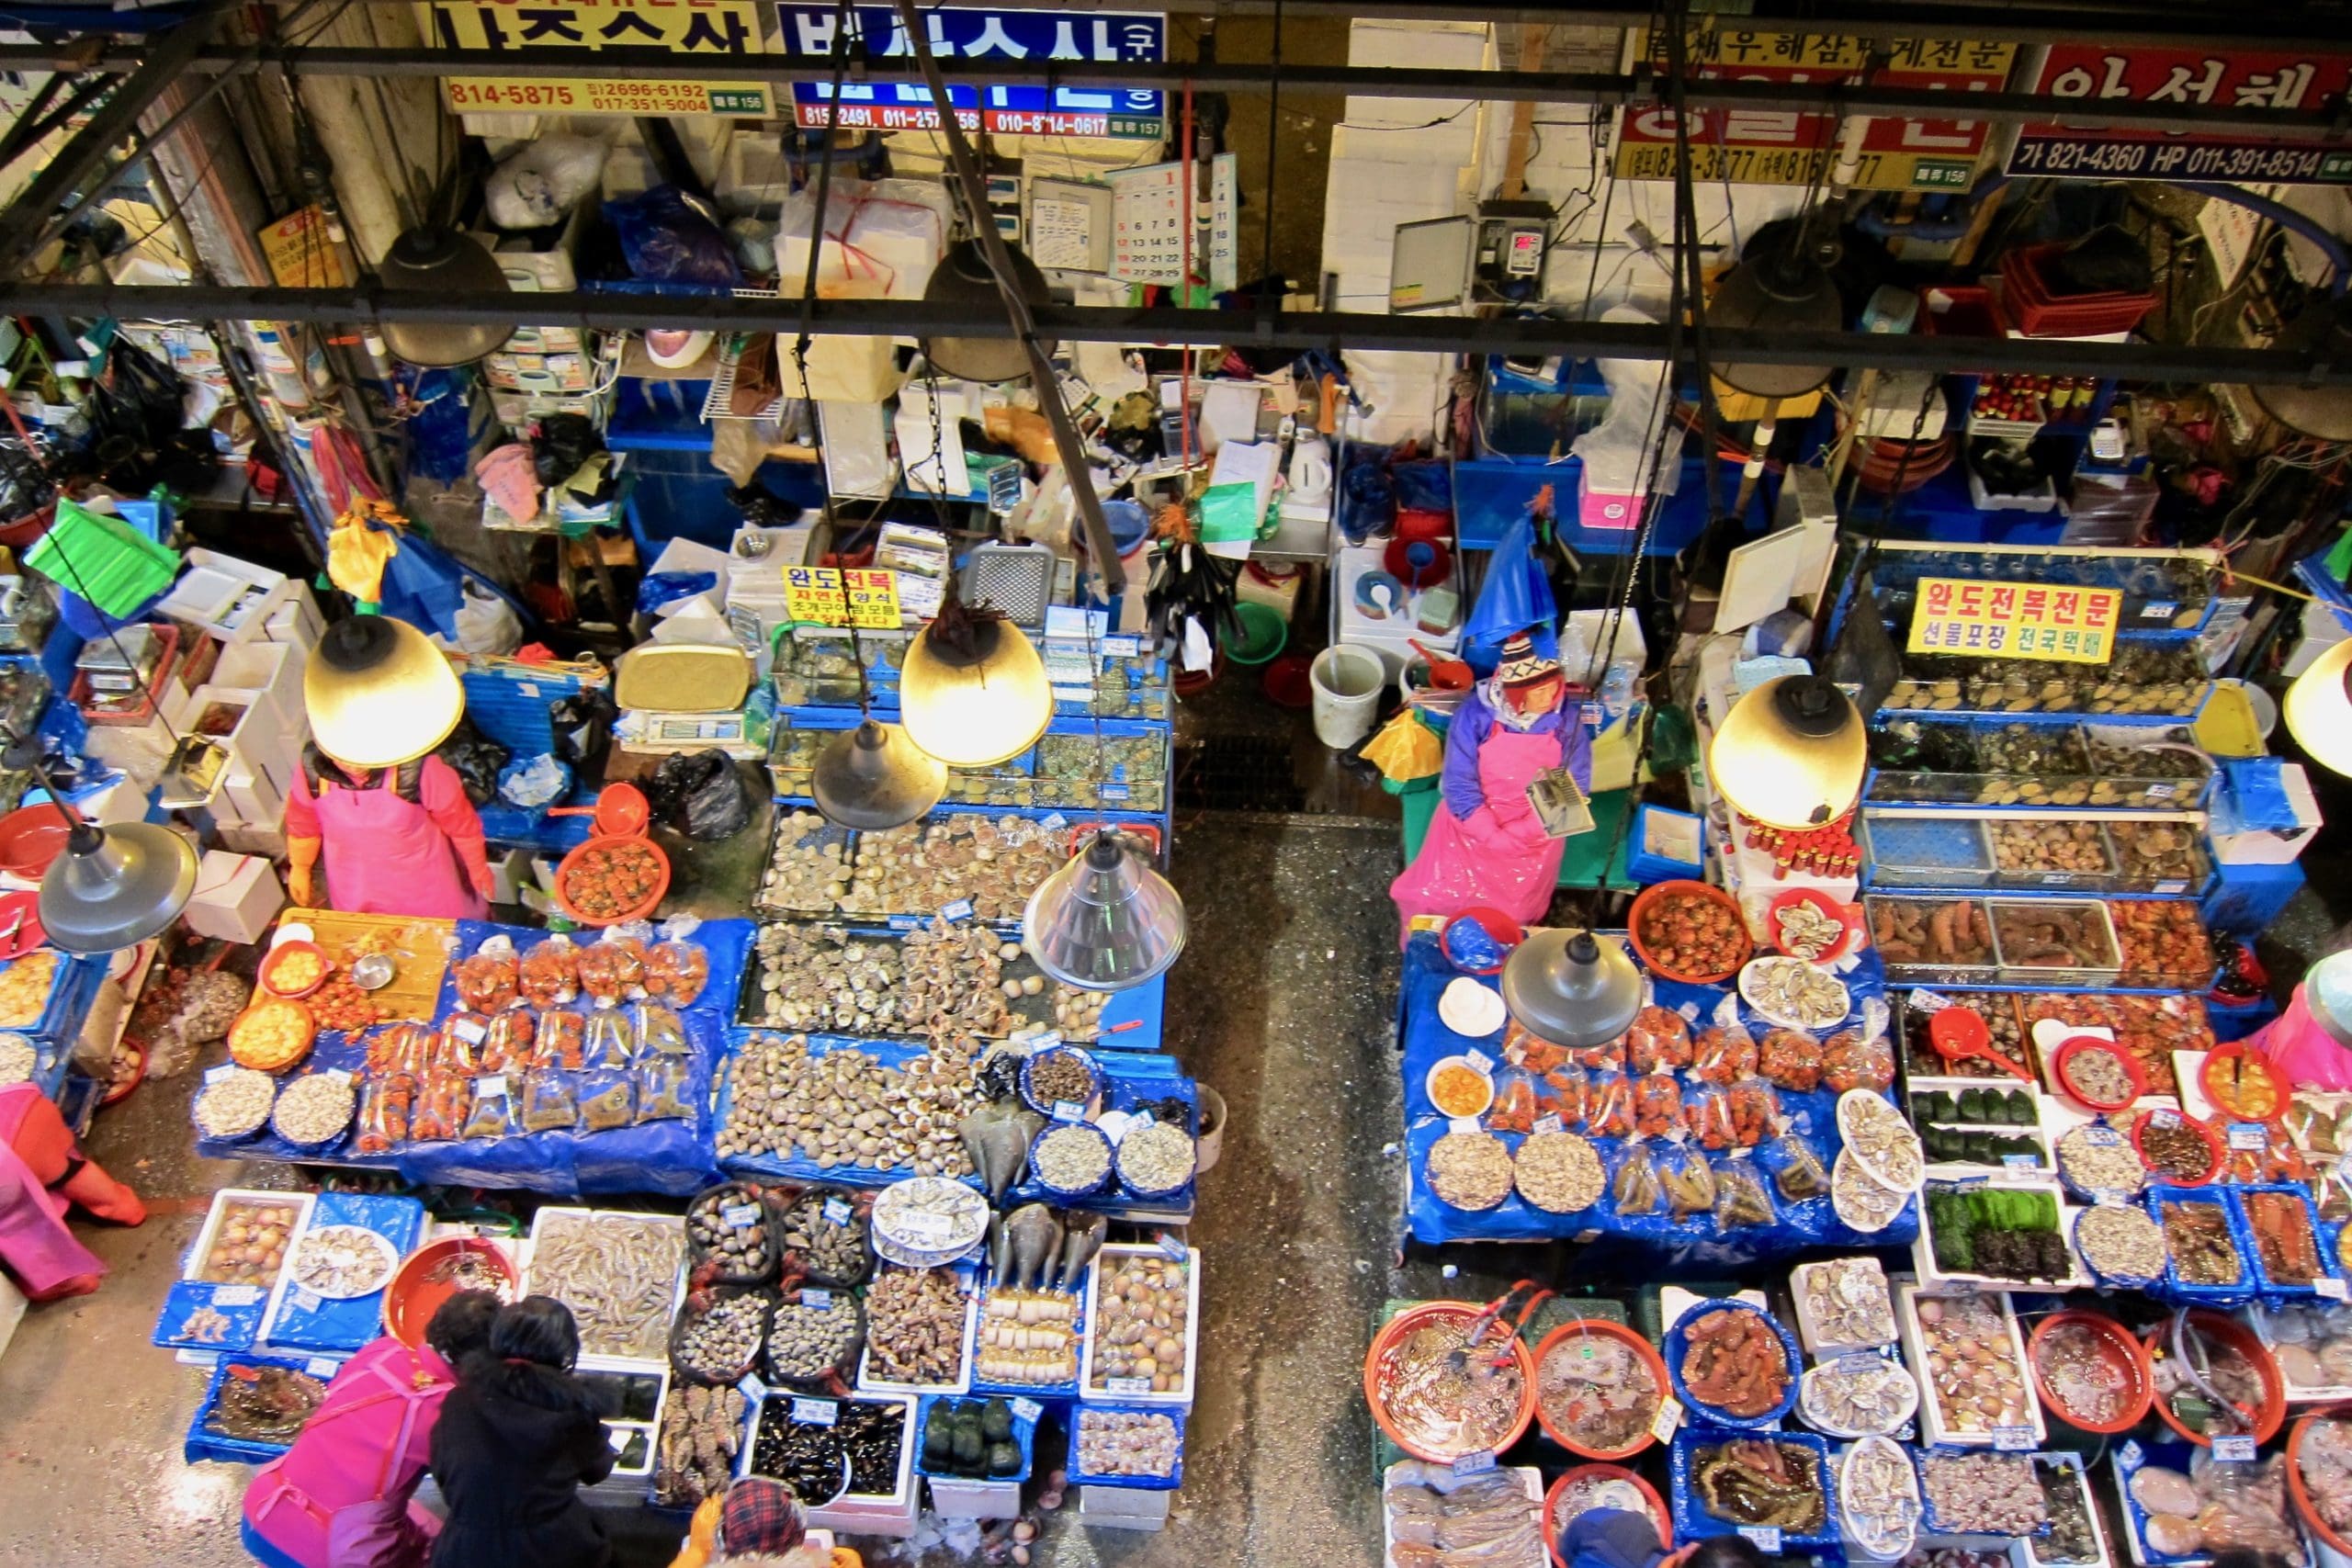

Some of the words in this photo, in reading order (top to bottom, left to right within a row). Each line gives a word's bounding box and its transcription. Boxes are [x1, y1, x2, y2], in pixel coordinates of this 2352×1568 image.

[450, 84, 573, 105] 814-5875
[594, 97, 708, 112] 017-351-5004
[1139, 122, 1160, 135] 157
[2045, 142, 2146, 172] 821-4360
[2150, 145, 2188, 172] HP
[2186, 147, 2323, 177] 011-391-8514
[1135, 222, 1142, 231] 6
[1151, 220, 1159, 229] 7
[1168, 219, 1176, 228] 8
[1133, 239, 1146, 247] 13
[1149, 238, 1161, 247] 14
[1166, 236, 1179, 245] 15
[1132, 254, 1147, 263] 20
[1149, 254, 1162, 263] 21
[1166, 254, 1180, 263] 22
[1927, 583, 2112, 627] 완도전복전문
[1923, 622, 2006, 650] 선물포장
[2018, 626, 2102, 657] 전국택배
